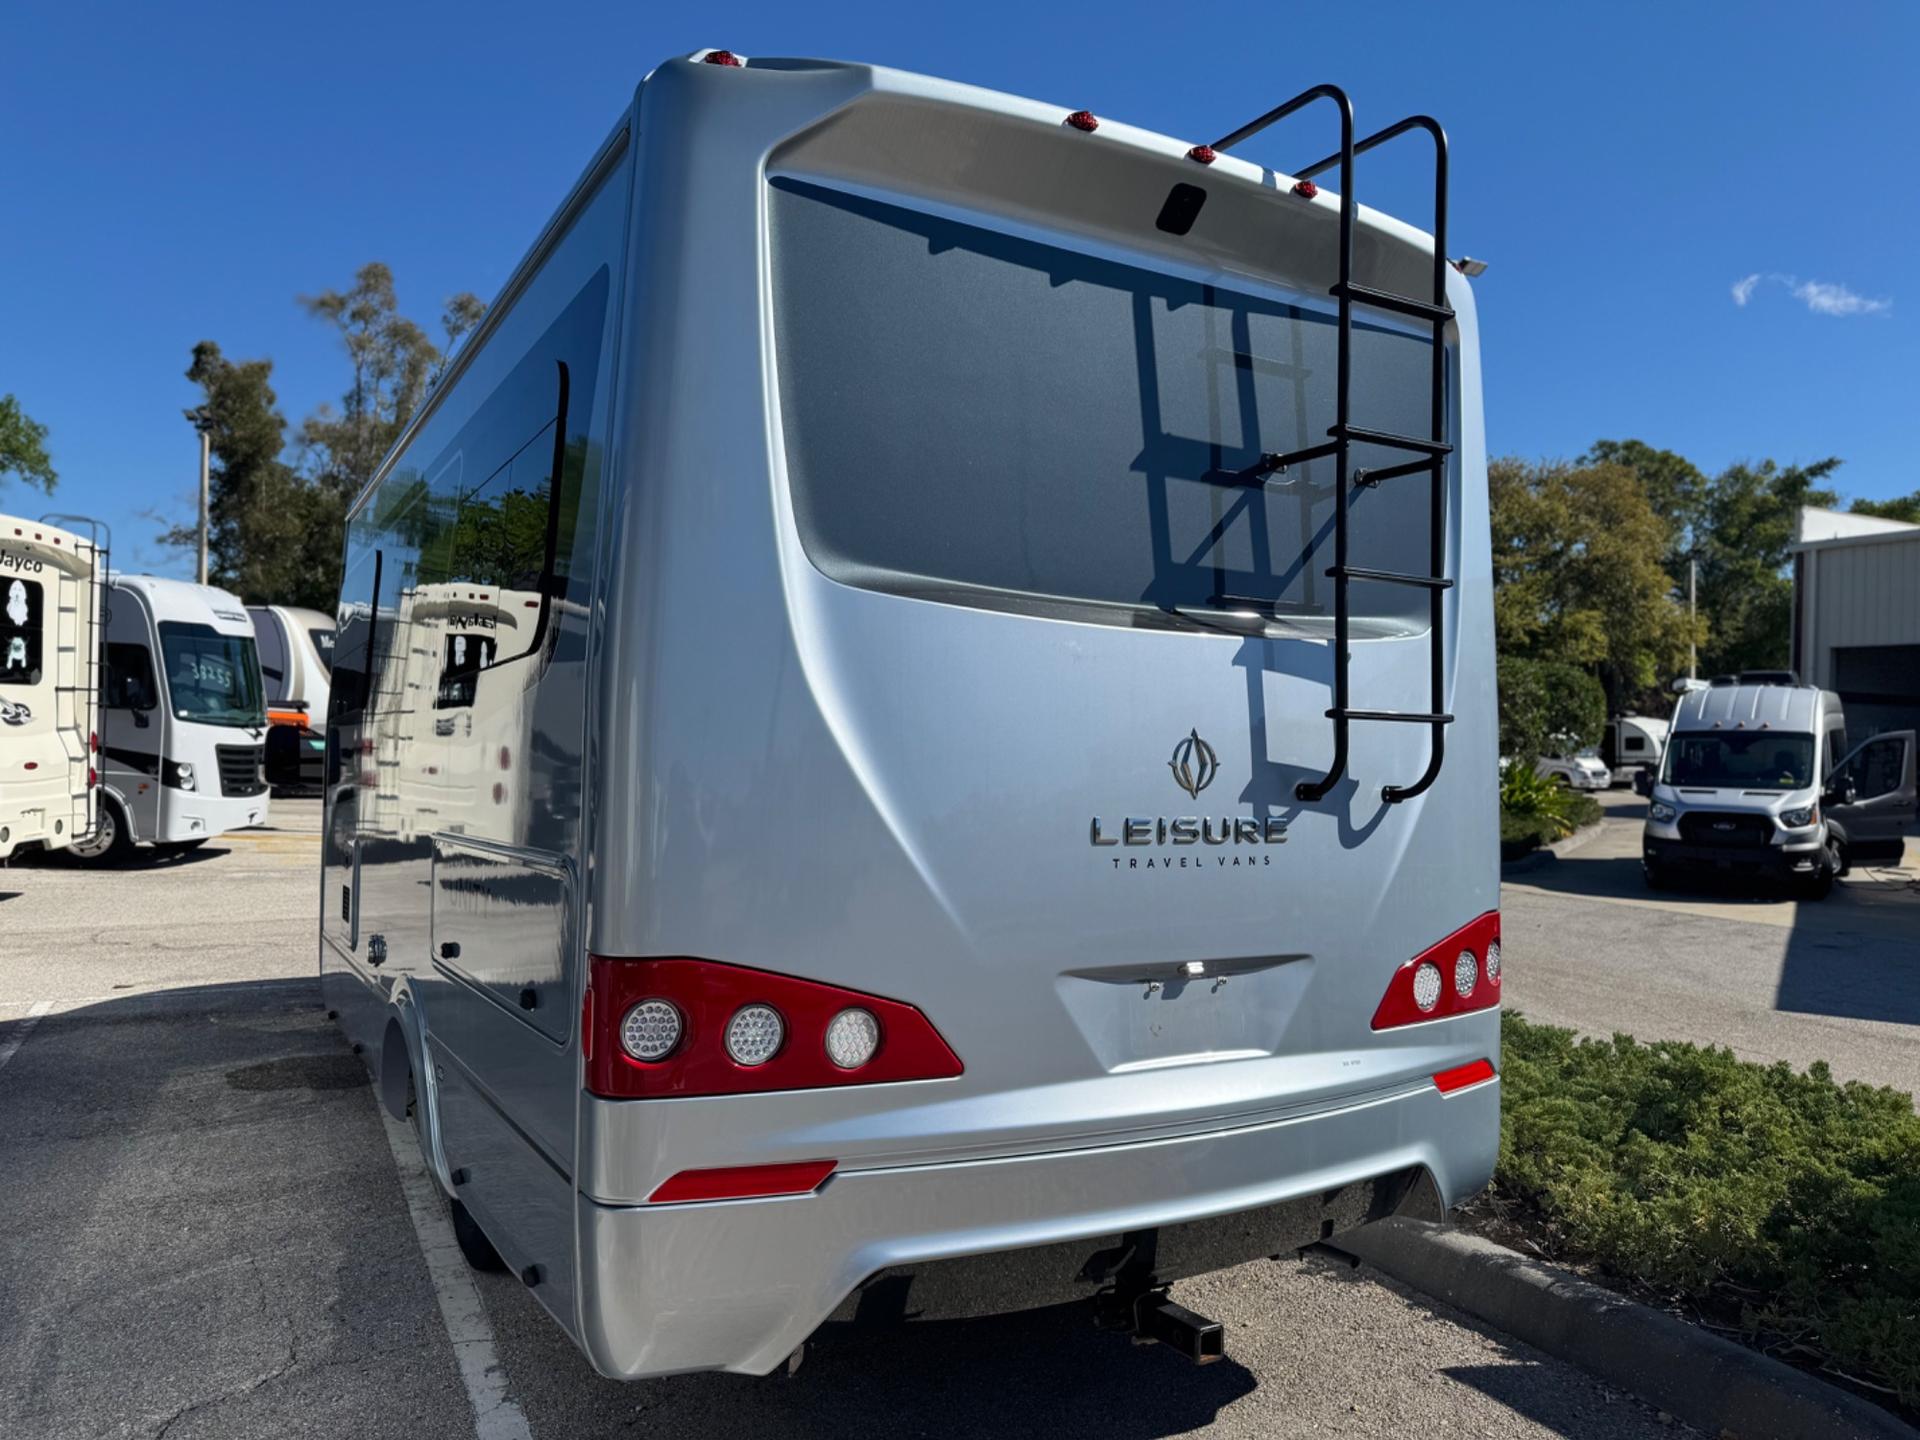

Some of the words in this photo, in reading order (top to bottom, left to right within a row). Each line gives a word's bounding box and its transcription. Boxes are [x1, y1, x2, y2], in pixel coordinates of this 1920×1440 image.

[0, 549, 43, 573] Jayco
[1090, 815, 1289, 847] LEISURE
[1112, 857, 1203, 869] TRAVEL
[1217, 855, 1271, 867] VANS
